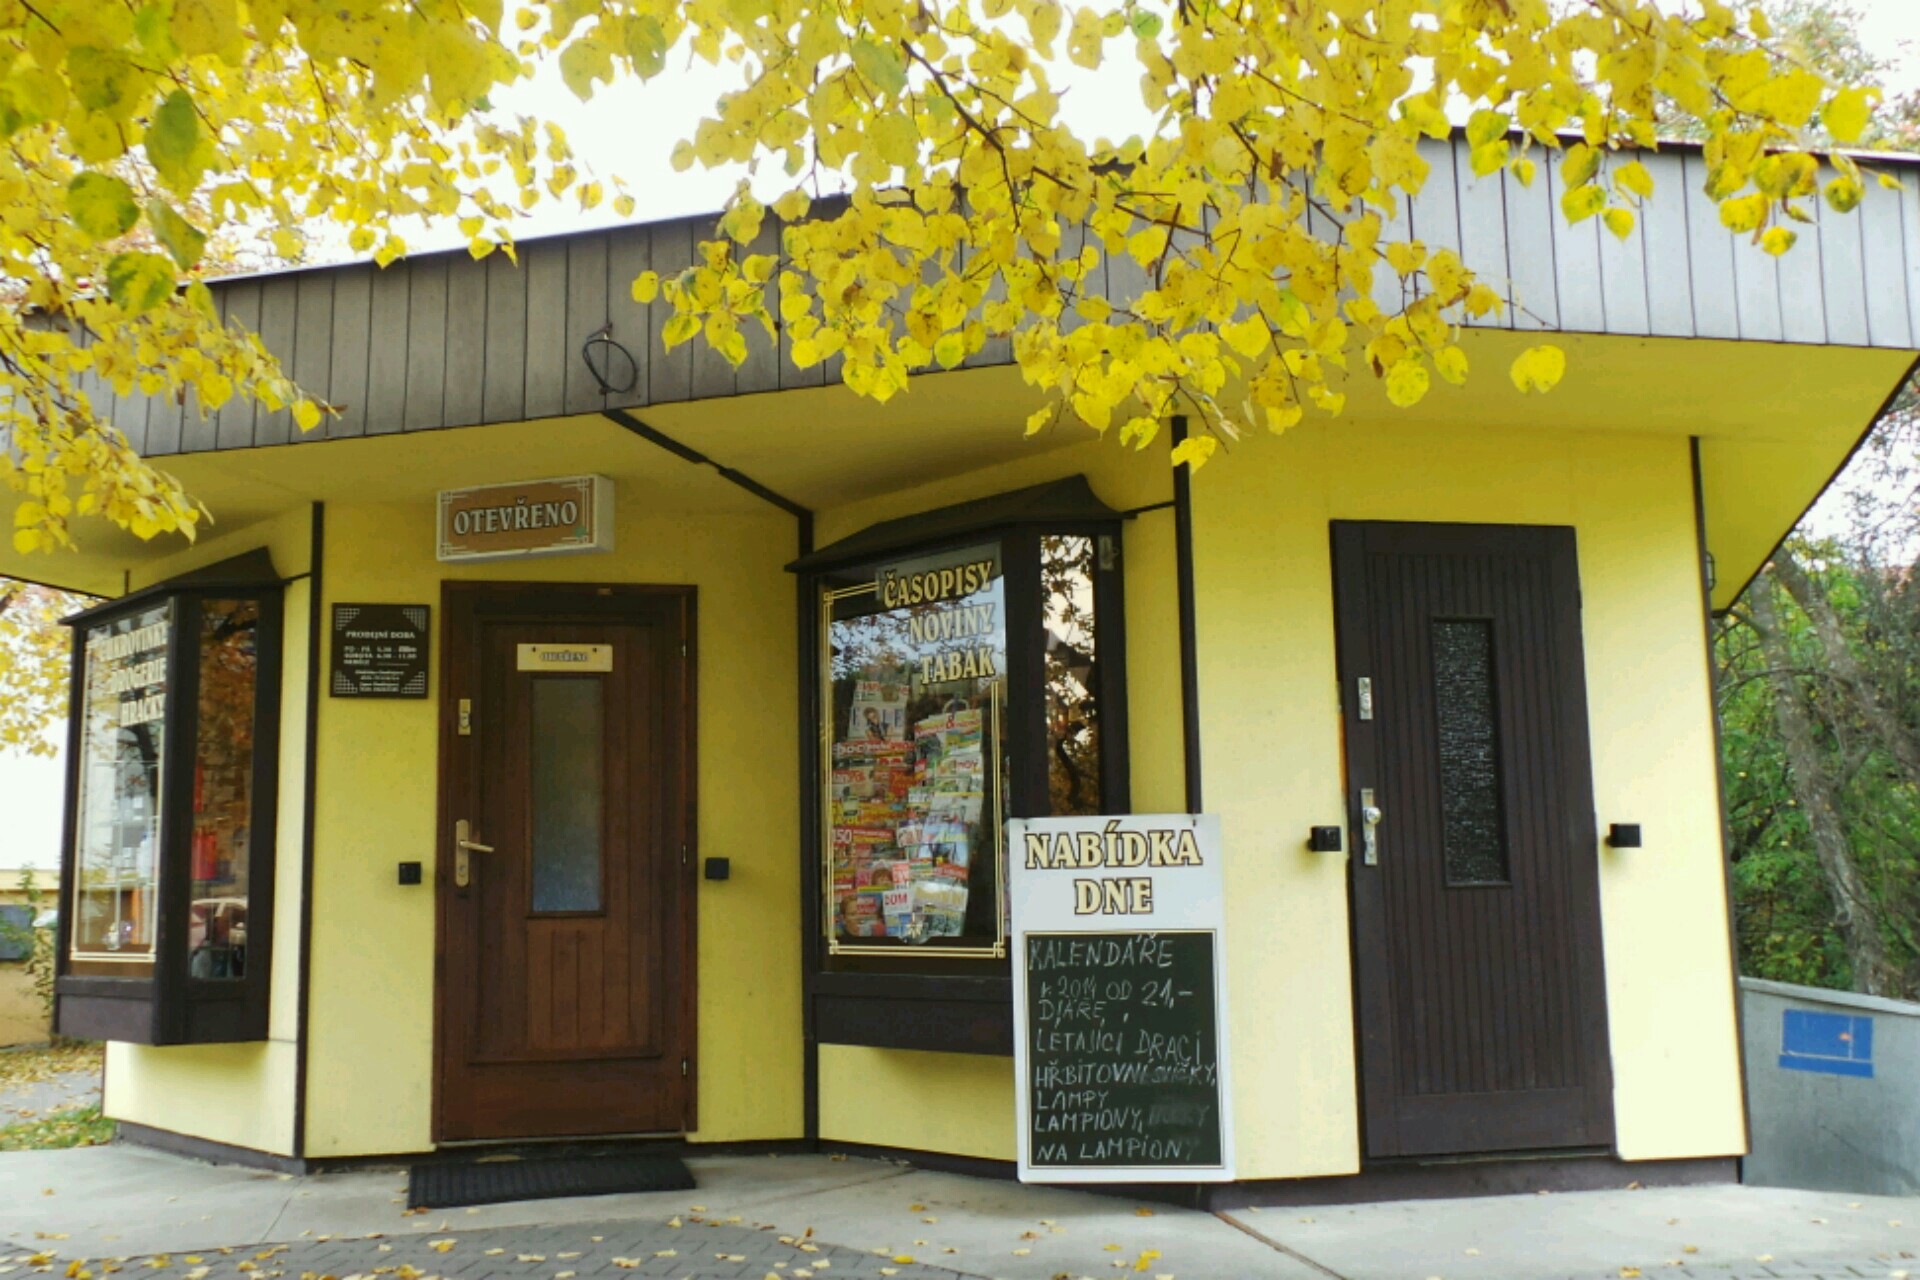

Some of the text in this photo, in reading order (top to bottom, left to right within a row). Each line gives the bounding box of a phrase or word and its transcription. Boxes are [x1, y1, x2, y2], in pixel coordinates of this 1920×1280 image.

[454, 497, 578, 535] OTEVŘENO
[883, 560, 993, 608] ČASOPISY
[908, 602, 995, 646] NOVINY
[919, 641, 995, 685] TABÁK
[1024, 819, 1204, 870] NABÍDKA
[1074, 876, 1154, 915] DNE
[1106, 980, 1133, 1001] OD
[1036, 1089, 1110, 1111] LAMPY
[1036, 1143, 1068, 1163] NA
